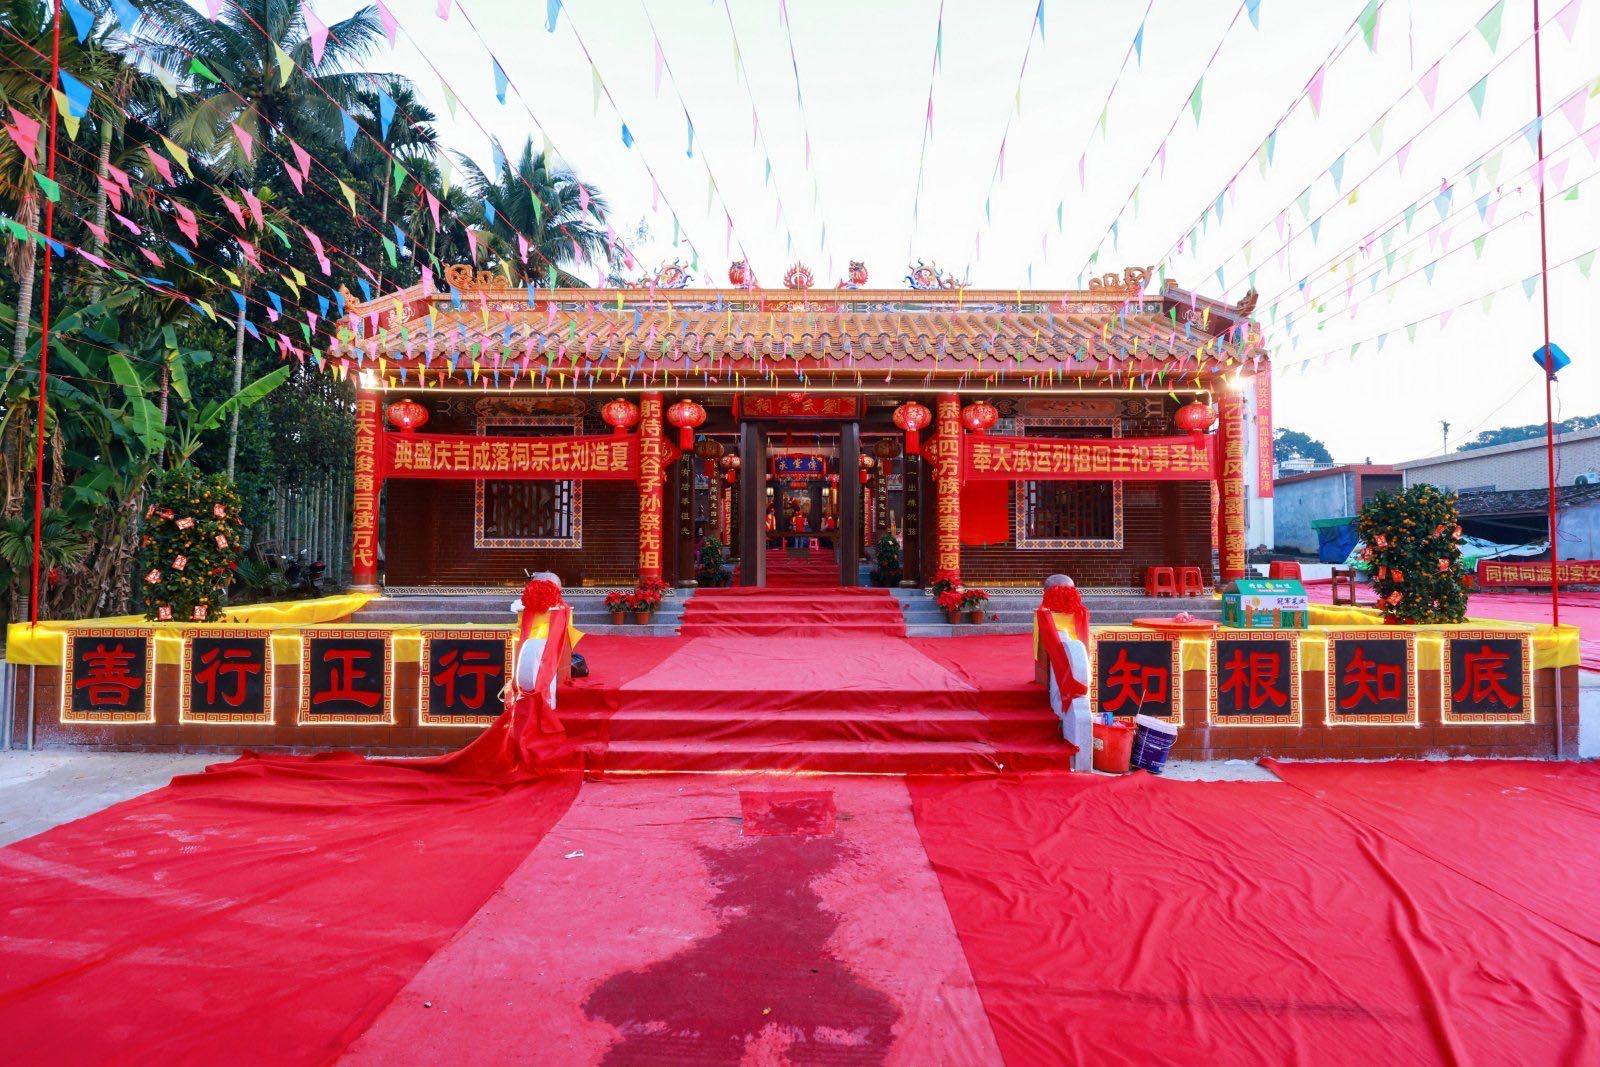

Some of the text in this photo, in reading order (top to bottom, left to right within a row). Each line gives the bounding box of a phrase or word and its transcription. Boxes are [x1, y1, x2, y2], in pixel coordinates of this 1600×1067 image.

[639, 399, 662, 569] 躬侍五谷子孙祭先祖
[938, 400, 960, 570] 恭迎四方族亲奉宗恩
[973, 441, 1209, 473] 奉天承运列祖回主祀事圣典
[76, 643, 501, 710] 善 行 正 行
[1103, 645, 1521, 712] 知 根 知 底
